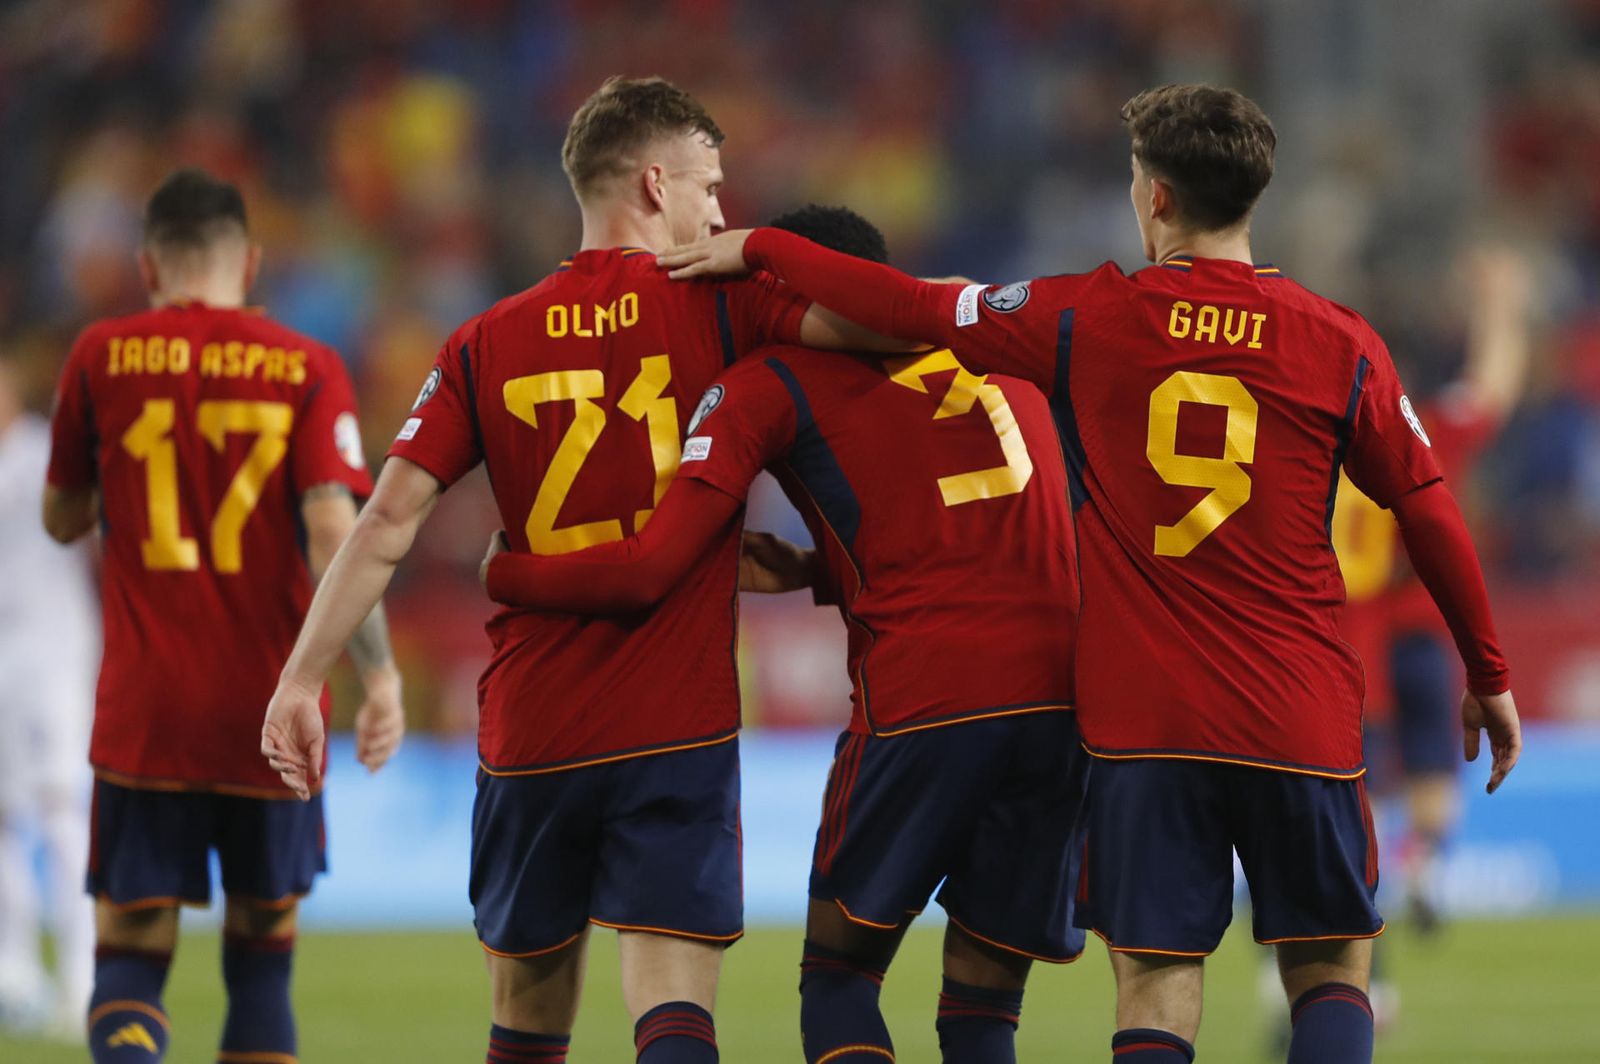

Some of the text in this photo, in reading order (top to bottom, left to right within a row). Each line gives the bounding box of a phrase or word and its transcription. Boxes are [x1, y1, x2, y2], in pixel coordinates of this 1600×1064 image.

[107, 335, 307, 386] IAGO ASPAS
[546, 292, 639, 338] OLMO
[1168, 300, 1267, 350] GAVI
[122, 398, 294, 575] 17
[502, 353, 681, 556] 21
[885, 346, 1033, 507] 3
[1146, 370, 1259, 557] 9
